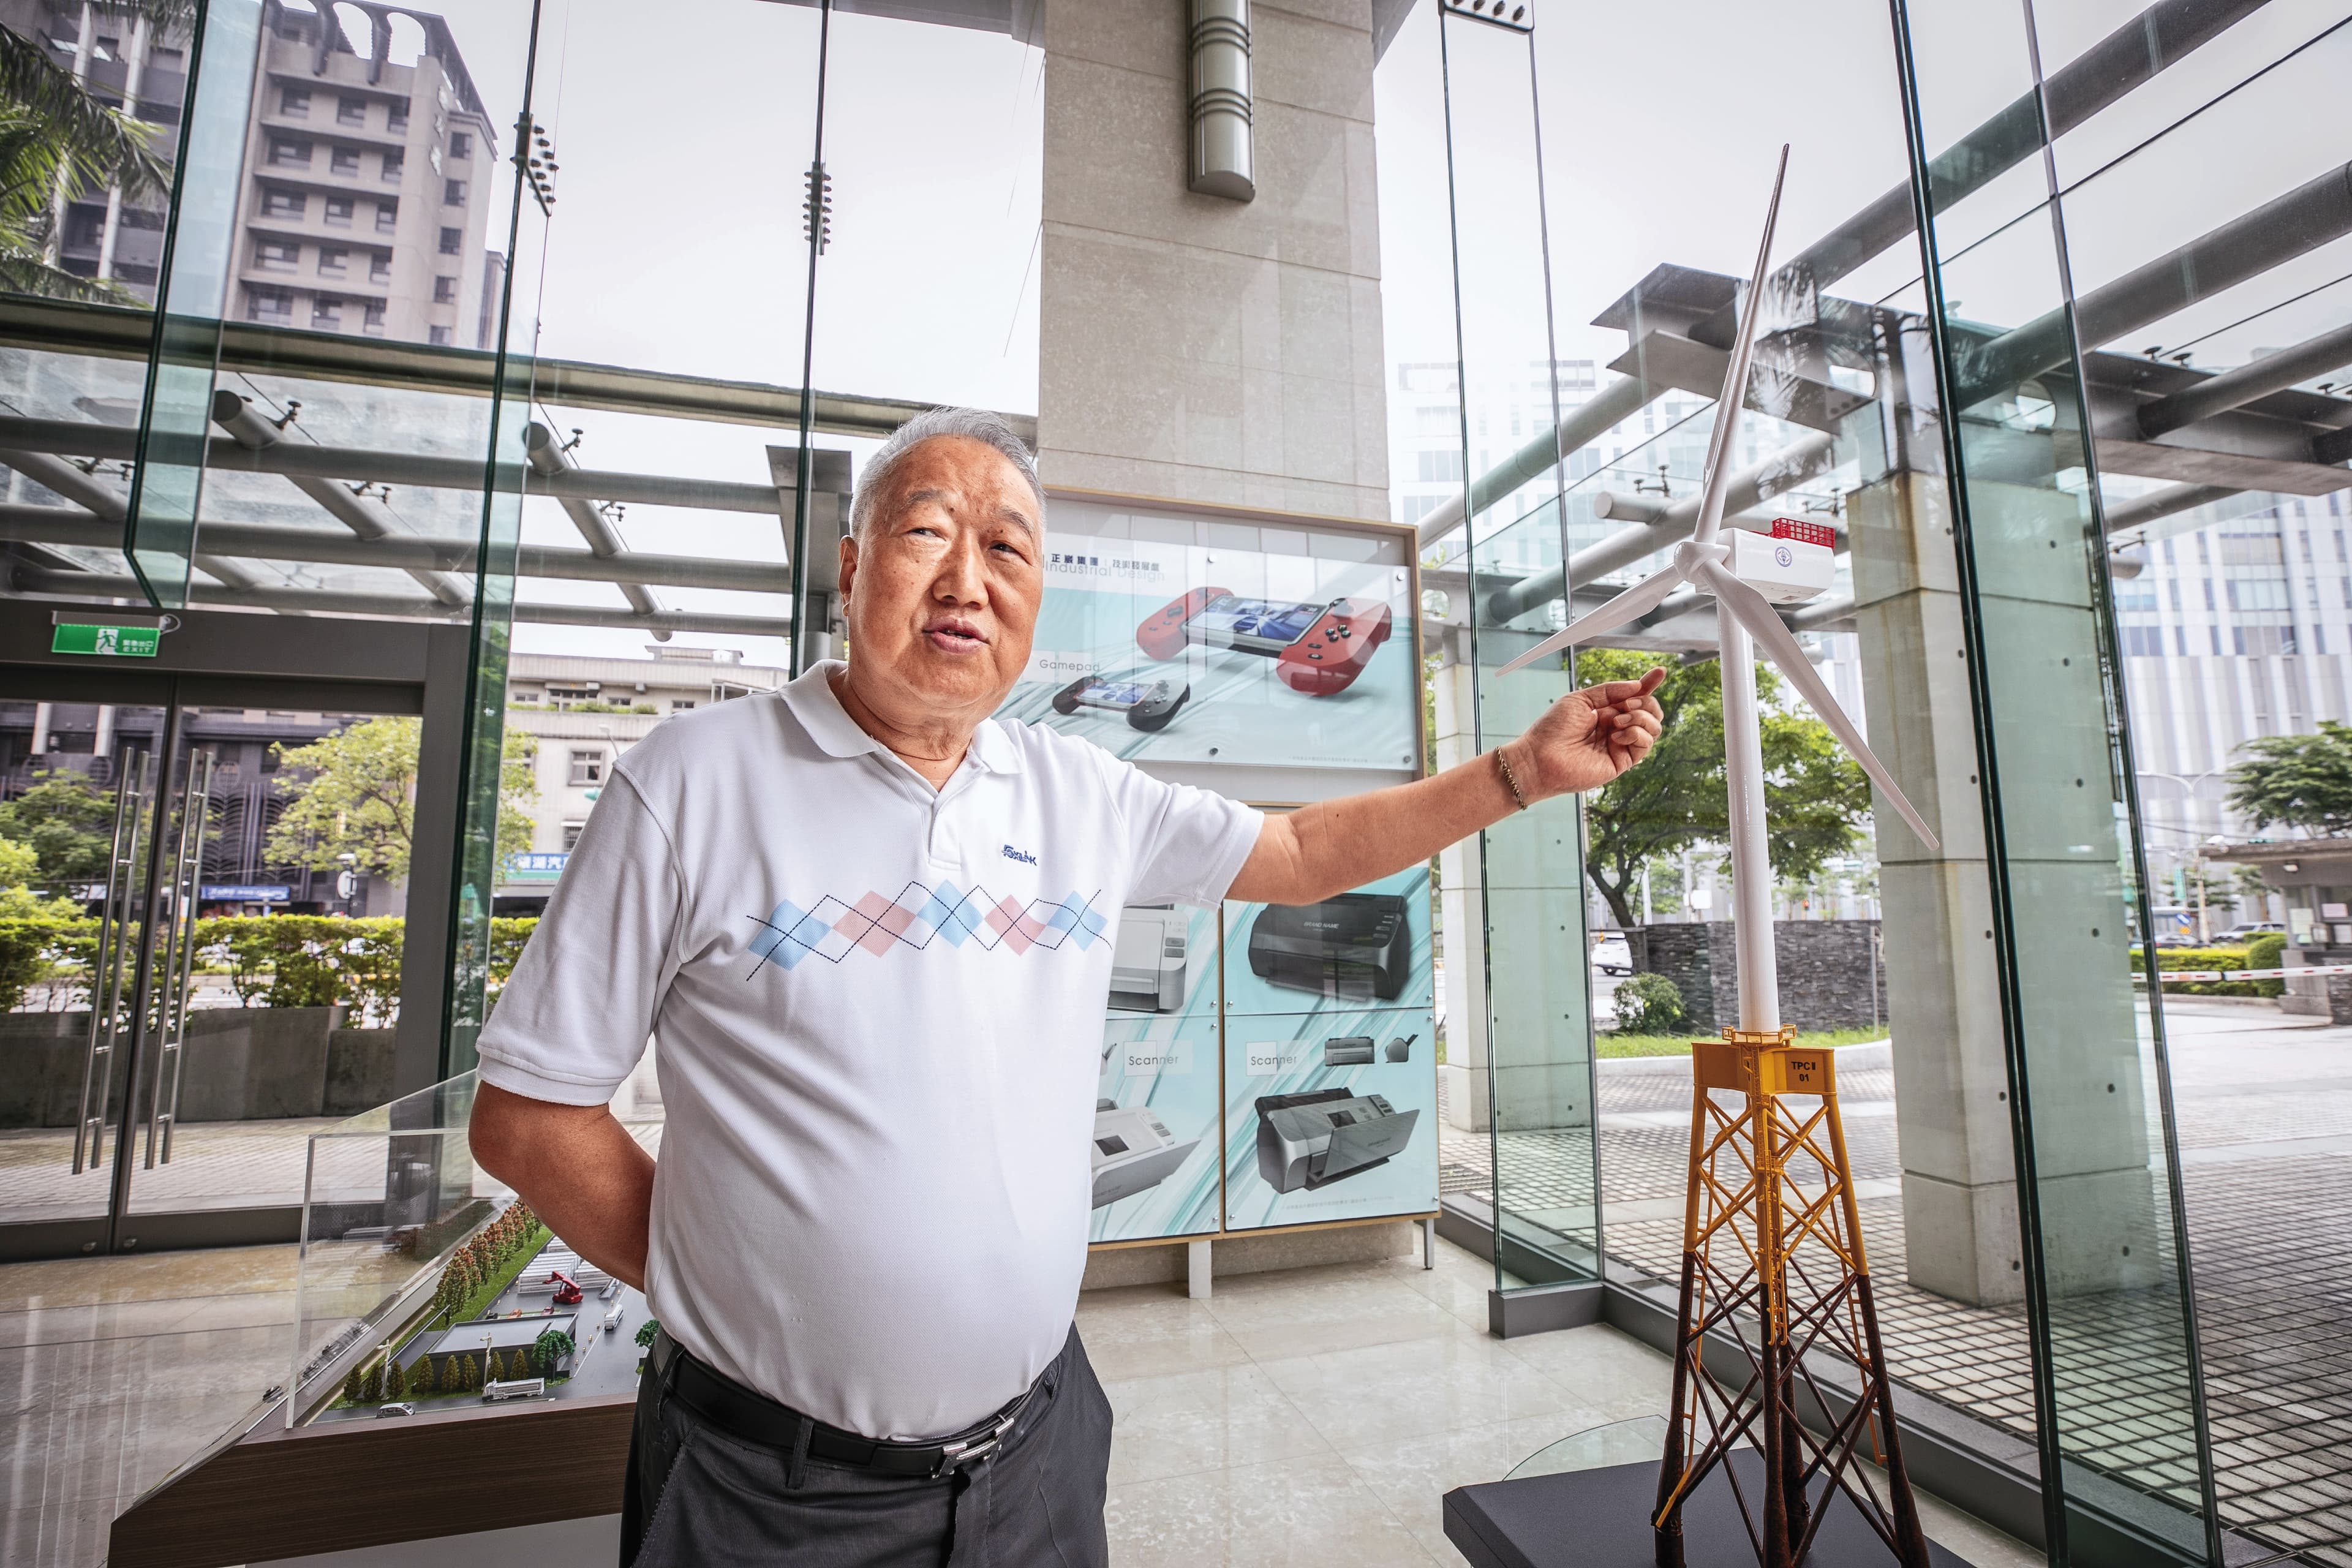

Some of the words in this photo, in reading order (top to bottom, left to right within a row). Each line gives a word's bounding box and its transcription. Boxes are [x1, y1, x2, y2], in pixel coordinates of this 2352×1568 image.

[1045, 561, 1112, 576] Industrial
[1117, 567, 1165, 582] Design
[1039, 659, 1100, 673] Gamepad
[1128, 1055, 1179, 1066] Scanner
[1250, 1055, 1297, 1066] Scanner
[1799, 1073, 1809, 1082] 01
